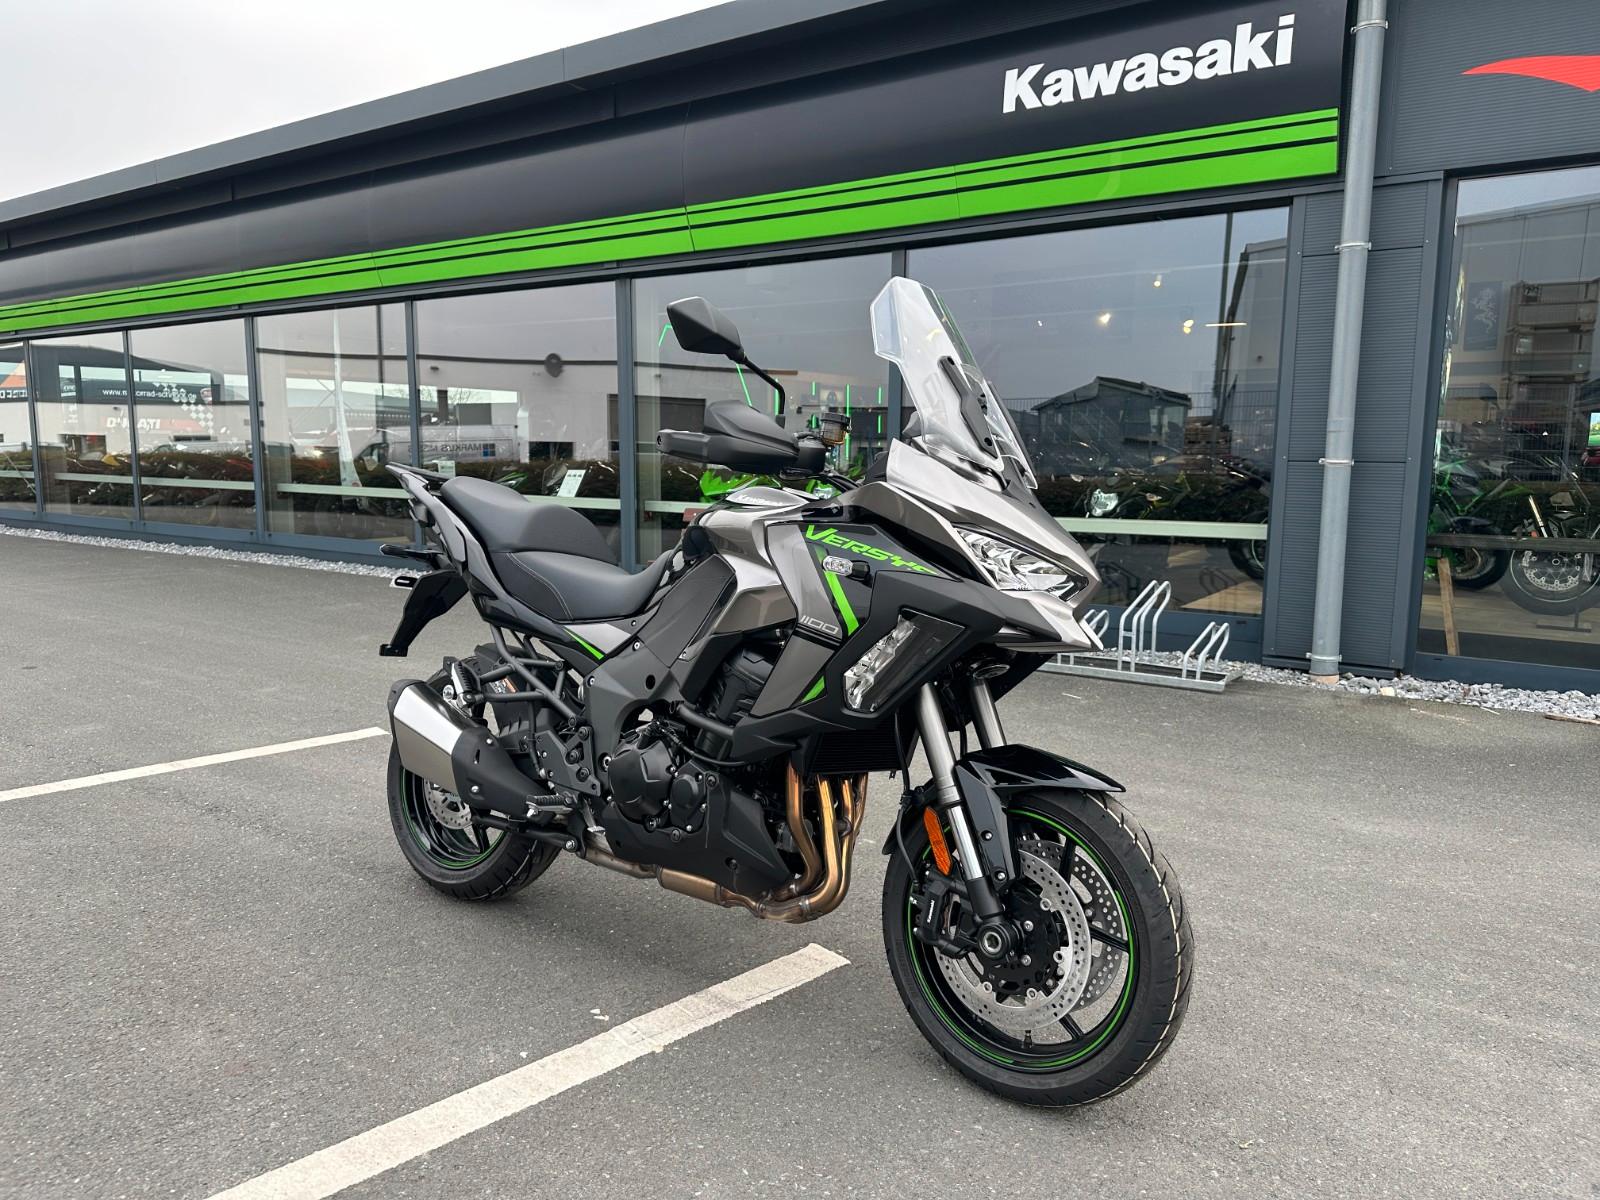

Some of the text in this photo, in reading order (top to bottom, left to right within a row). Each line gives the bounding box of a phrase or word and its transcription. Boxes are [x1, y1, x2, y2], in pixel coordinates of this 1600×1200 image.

[1002, 13, 1295, 114] Kawasaki
[805, 524, 938, 575] VERSYS
[798, 614, 839, 635] 1100
